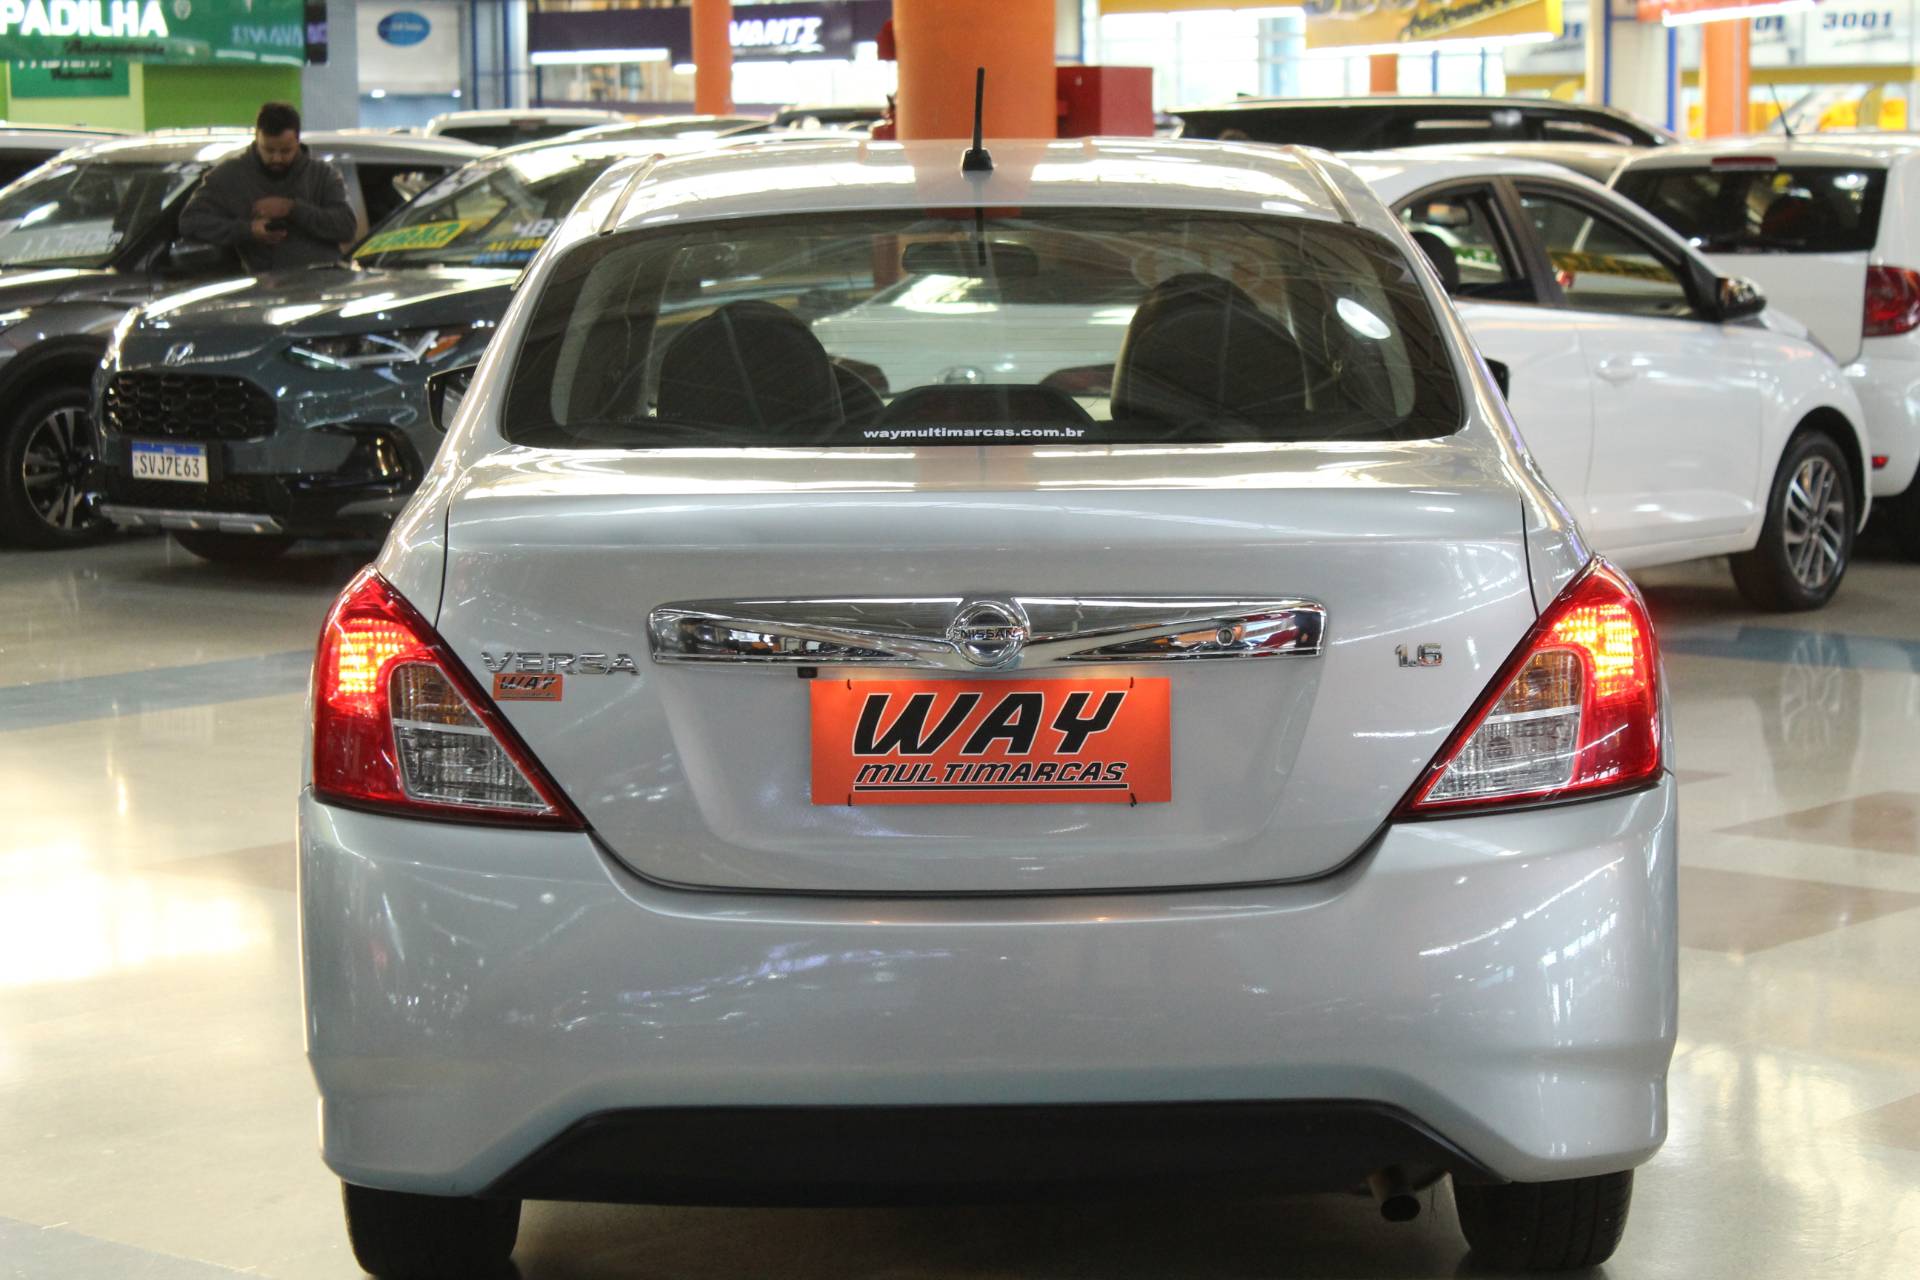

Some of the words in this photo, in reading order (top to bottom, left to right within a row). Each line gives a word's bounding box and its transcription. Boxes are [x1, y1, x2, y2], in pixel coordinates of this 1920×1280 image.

[0, 0, 168, 37] PADILHA
[863, 427, 1085, 440] waymultimarcas.com.br
[140, 453, 200, 477] SVJ7E63
[960, 628, 1016, 640] NISSAN
[481, 651, 641, 676] VERSA
[1394, 642, 1442, 668] 1.6
[853, 691, 1129, 757] WAY
[855, 762, 1129, 784] MULTIMARCAS
